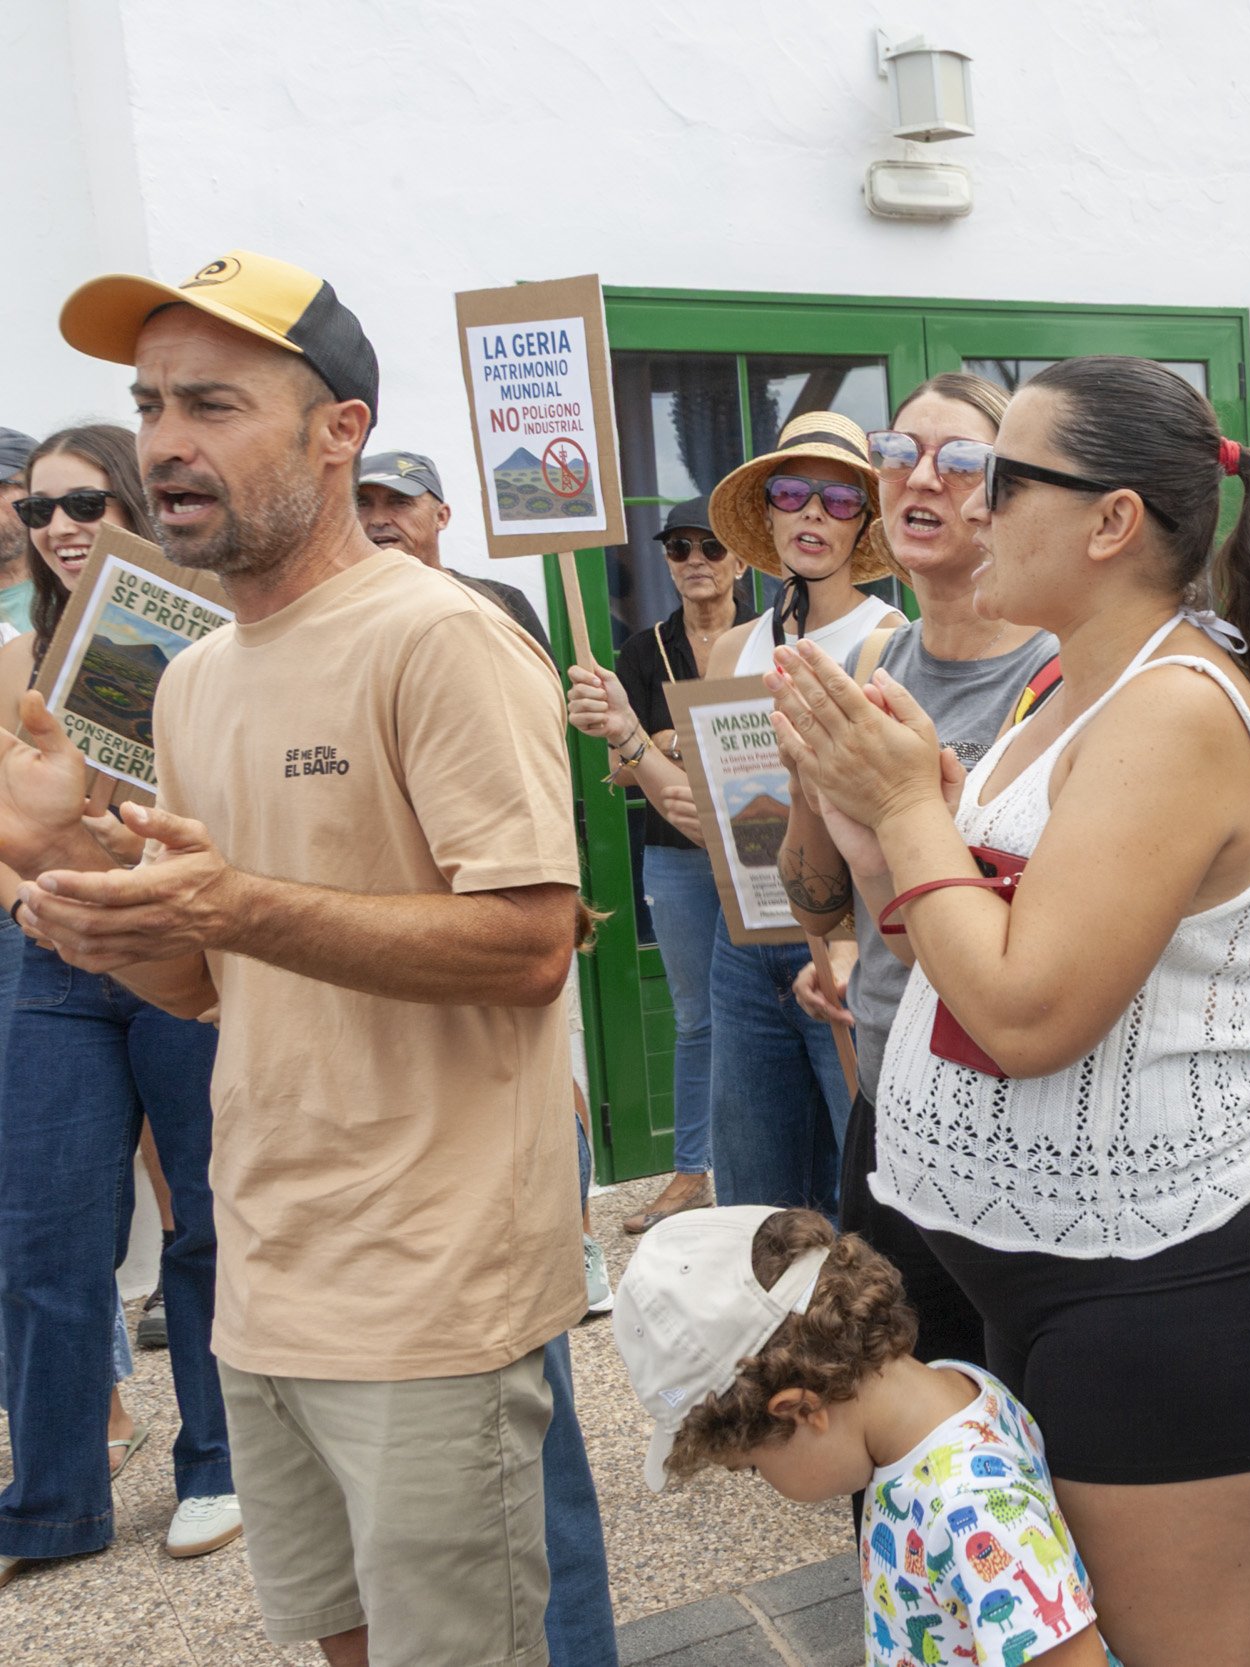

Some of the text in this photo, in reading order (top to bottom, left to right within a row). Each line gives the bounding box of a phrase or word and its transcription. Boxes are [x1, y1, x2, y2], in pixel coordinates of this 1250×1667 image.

[483, 329, 572, 360] LA GERIA
[484, 359, 569, 383] PATRIMONIO
[500, 381, 562, 402] MUNDIAL
[490, 407, 521, 434] NO
[523, 419, 585, 436] INDUSTRIAL
[111, 585, 140, 610] SE
[118, 570, 231, 630] LO QUE SE QUIE
[711, 710, 773, 737] ¡MASDA
[285, 748, 300, 762] SE
[314, 745, 337, 760] FUE
[720, 734, 740, 752] SE
[285, 758, 350, 778] EL BAIFO
